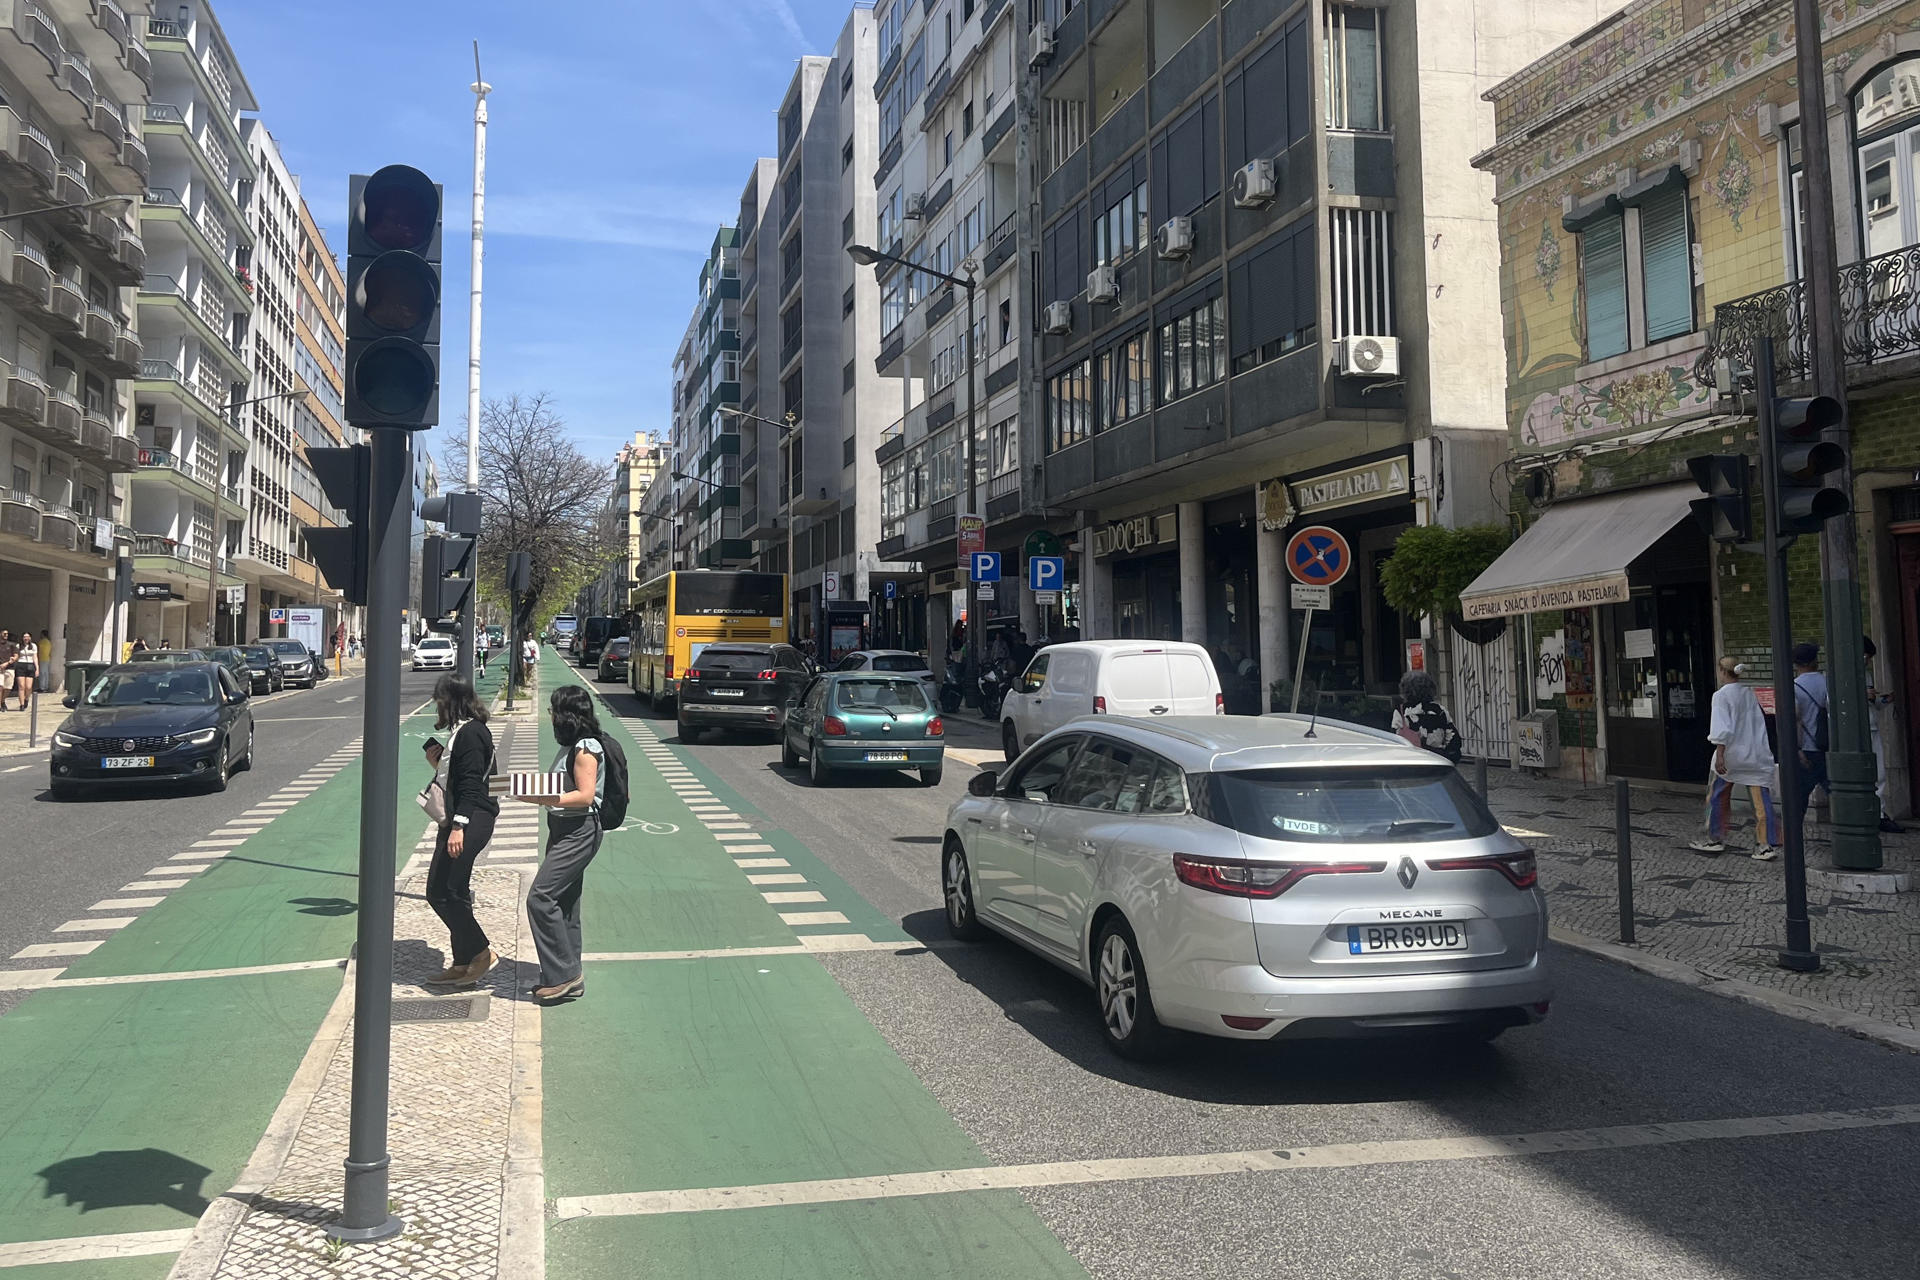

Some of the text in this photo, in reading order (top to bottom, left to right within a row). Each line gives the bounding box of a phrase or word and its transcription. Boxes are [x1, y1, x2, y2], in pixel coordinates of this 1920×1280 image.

[1300, 470, 1381, 507] PASTELARIA
[1107, 516, 1153, 554] DOCEL
[977, 554, 995, 579] P
[1036, 560, 1057, 588] P
[886, 582, 894, 598] P
[1469, 604, 1502, 617] CAFETARIA
[1504, 596, 1529, 612] SNACK
[1577, 585, 1620, 603] PASTELARIA
[1286, 820, 1317, 832] TVDE
[1379, 909, 1443, 919] MEGANE
